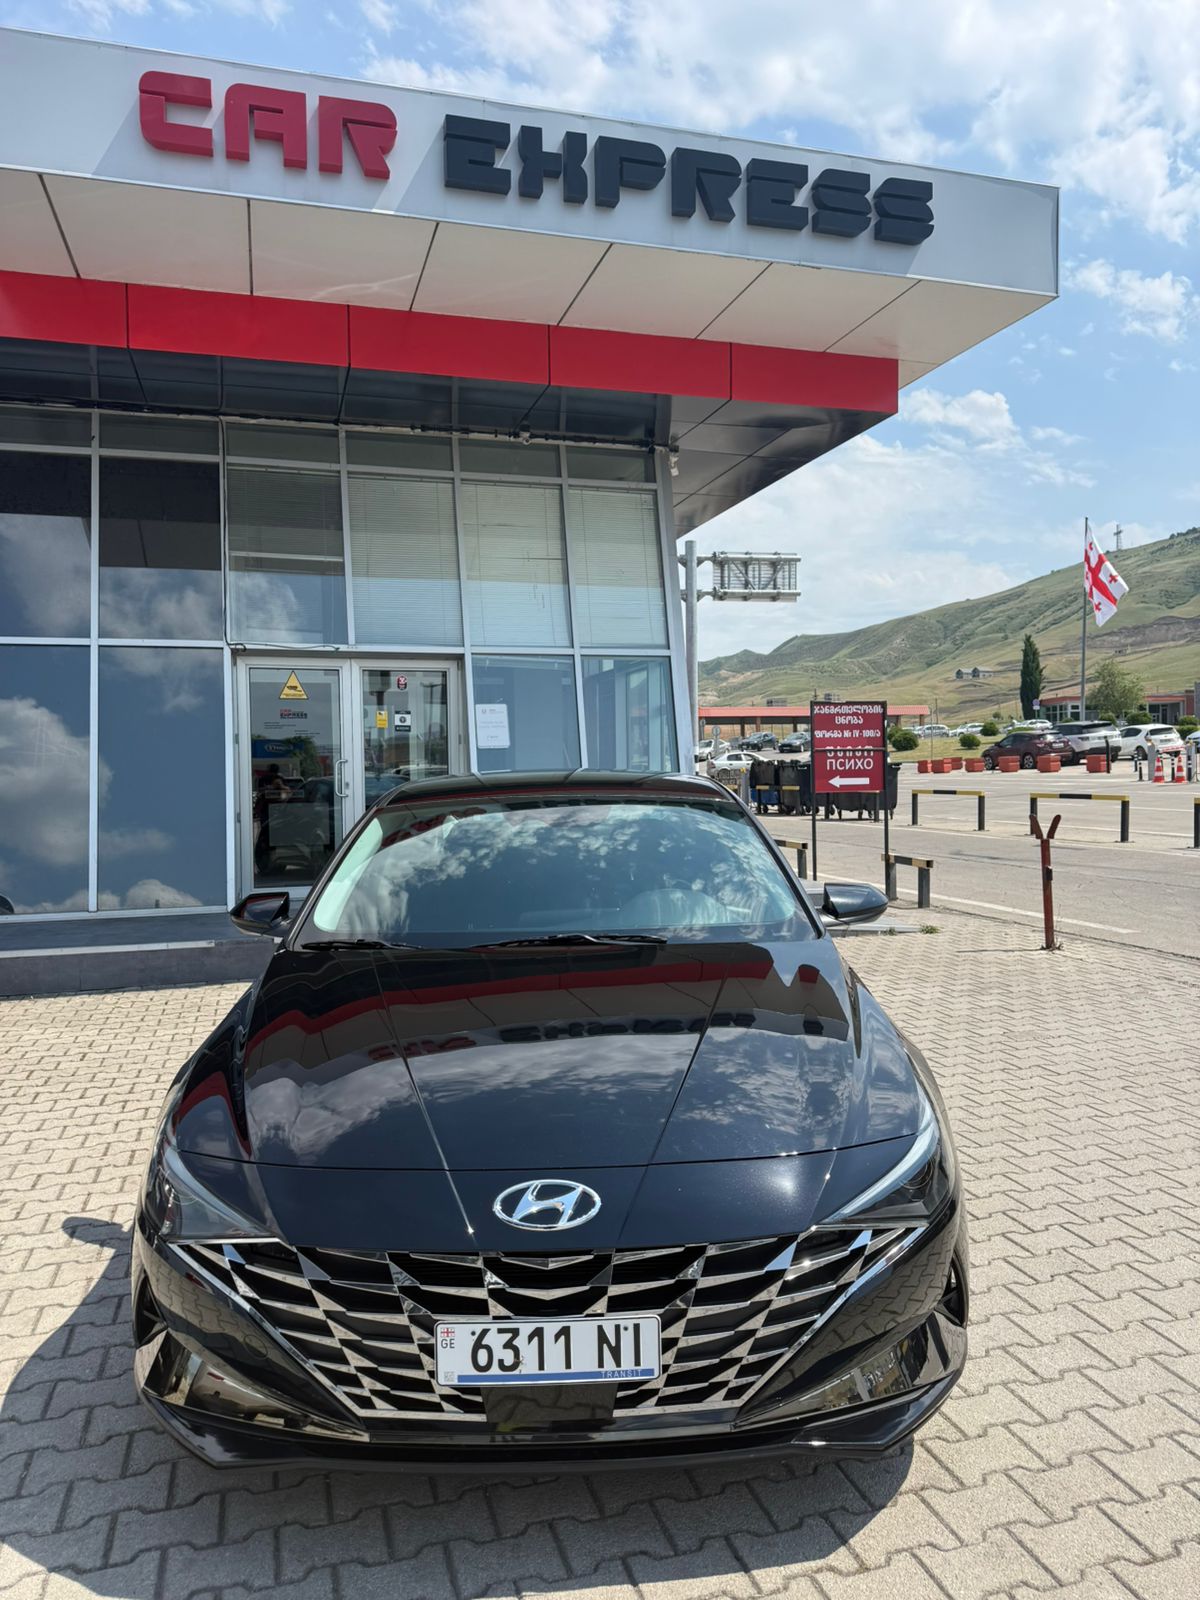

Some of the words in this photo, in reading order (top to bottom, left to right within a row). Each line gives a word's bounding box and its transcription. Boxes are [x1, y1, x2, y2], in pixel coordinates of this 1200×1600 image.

[139, 70, 398, 180] CAR
[444, 114, 935, 247] EXPRESS
[835, 715, 863, 724] ცნობა
[826, 759, 874, 770] ПСИХО
[440, 1338, 456, 1349] GE
[470, 1325, 572, 1373] 6311
[597, 1323, 641, 1369] NI
[601, 1369, 642, 1379] TRANSIT
